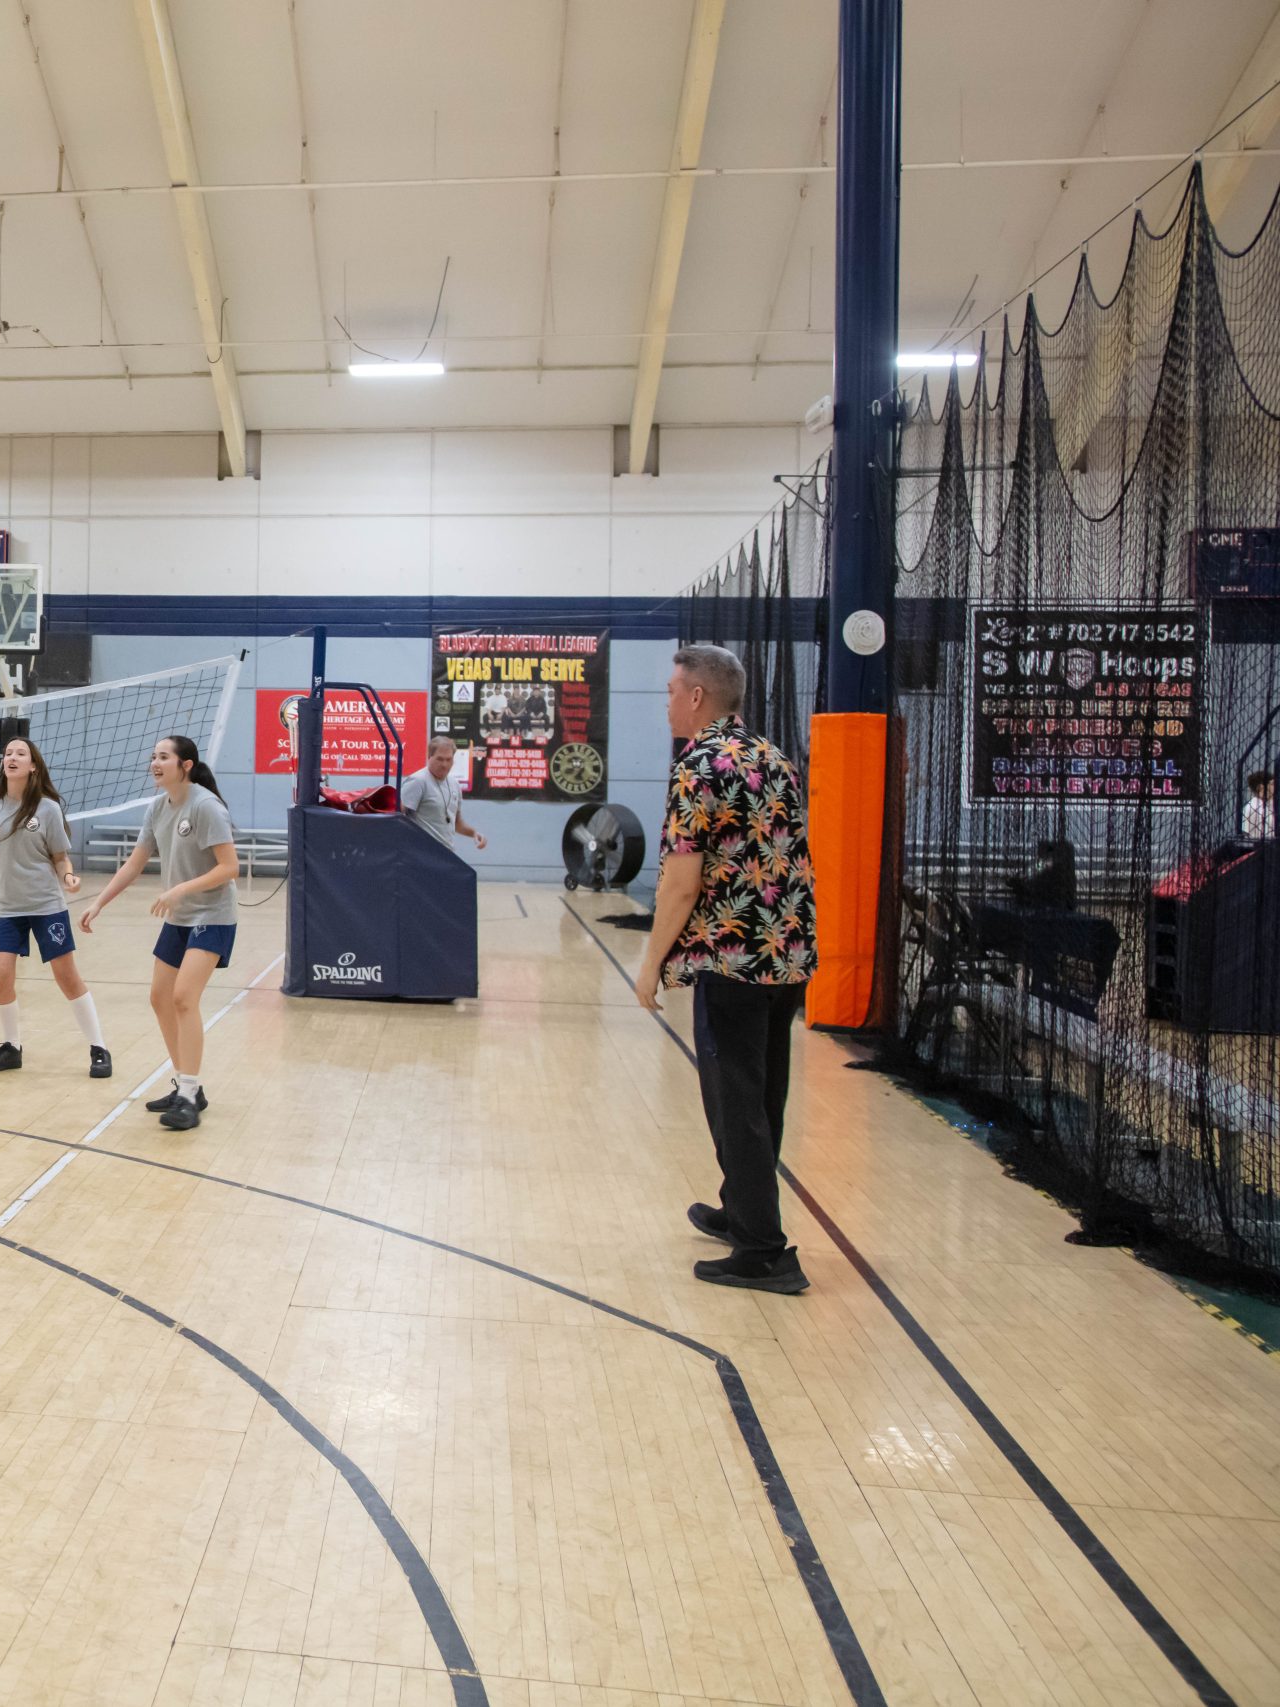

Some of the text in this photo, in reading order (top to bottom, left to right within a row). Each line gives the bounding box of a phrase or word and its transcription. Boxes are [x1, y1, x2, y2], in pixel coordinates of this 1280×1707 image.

[1067, 624, 1102, 642] 702
[1106, 624, 1138, 642] 717
[1145, 624, 1195, 642] 3542
[496, 634, 558, 653] BASKETBALL
[559, 635, 598, 653] LEAGUE
[446, 657, 492, 681] VEGAS
[494, 658, 539, 681] "LIGA"
[982, 651, 1008, 676] S
[1100, 651, 1196, 682] Hoops
[985, 684, 1005, 694] WE
[1095, 682, 1129, 697] LAS
[992, 758, 1183, 777] BASKETBALL
[992, 777, 1180, 795] VOLLEYBALL
[313, 964, 383, 982] SPALDING
